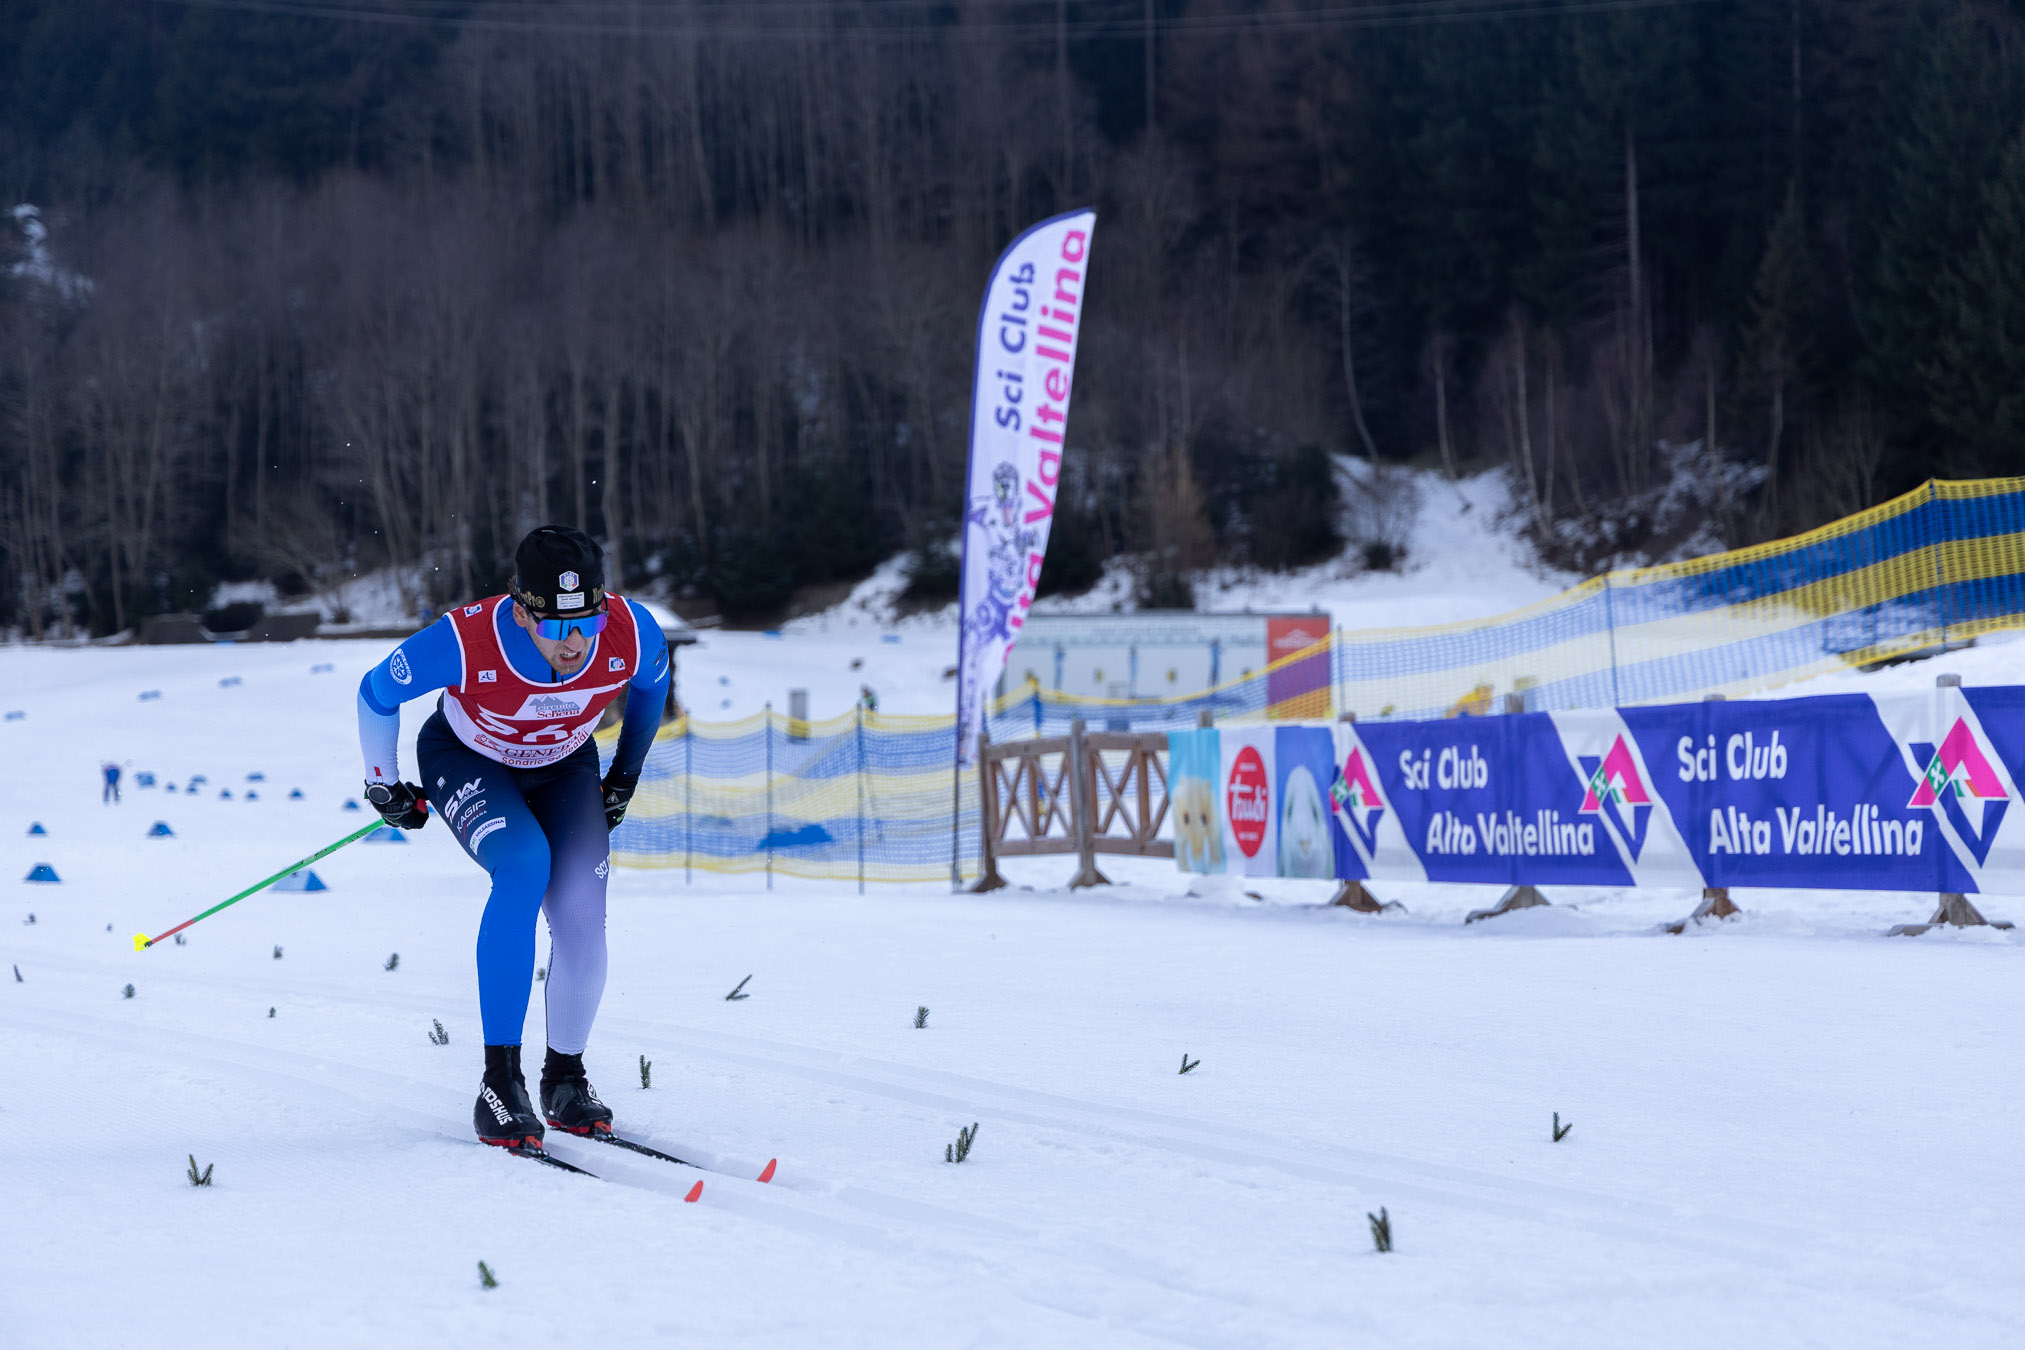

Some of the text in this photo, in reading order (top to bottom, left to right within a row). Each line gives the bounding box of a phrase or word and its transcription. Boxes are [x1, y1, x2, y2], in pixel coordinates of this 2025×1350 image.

[995, 262, 1035, 431] Sci Club
[1024, 230, 1086, 524] Valtellina
[537, 710, 580, 718] Schena
[502, 757, 543, 766] Sondrio
[1400, 745, 1489, 790] Sci Club
[1677, 730, 1788, 783] Sci Club
[457, 800, 487, 834] KAGIP
[1425, 809, 1596, 856] Alta Valtellina
[1708, 804, 1924, 857] Alta Valtellina
